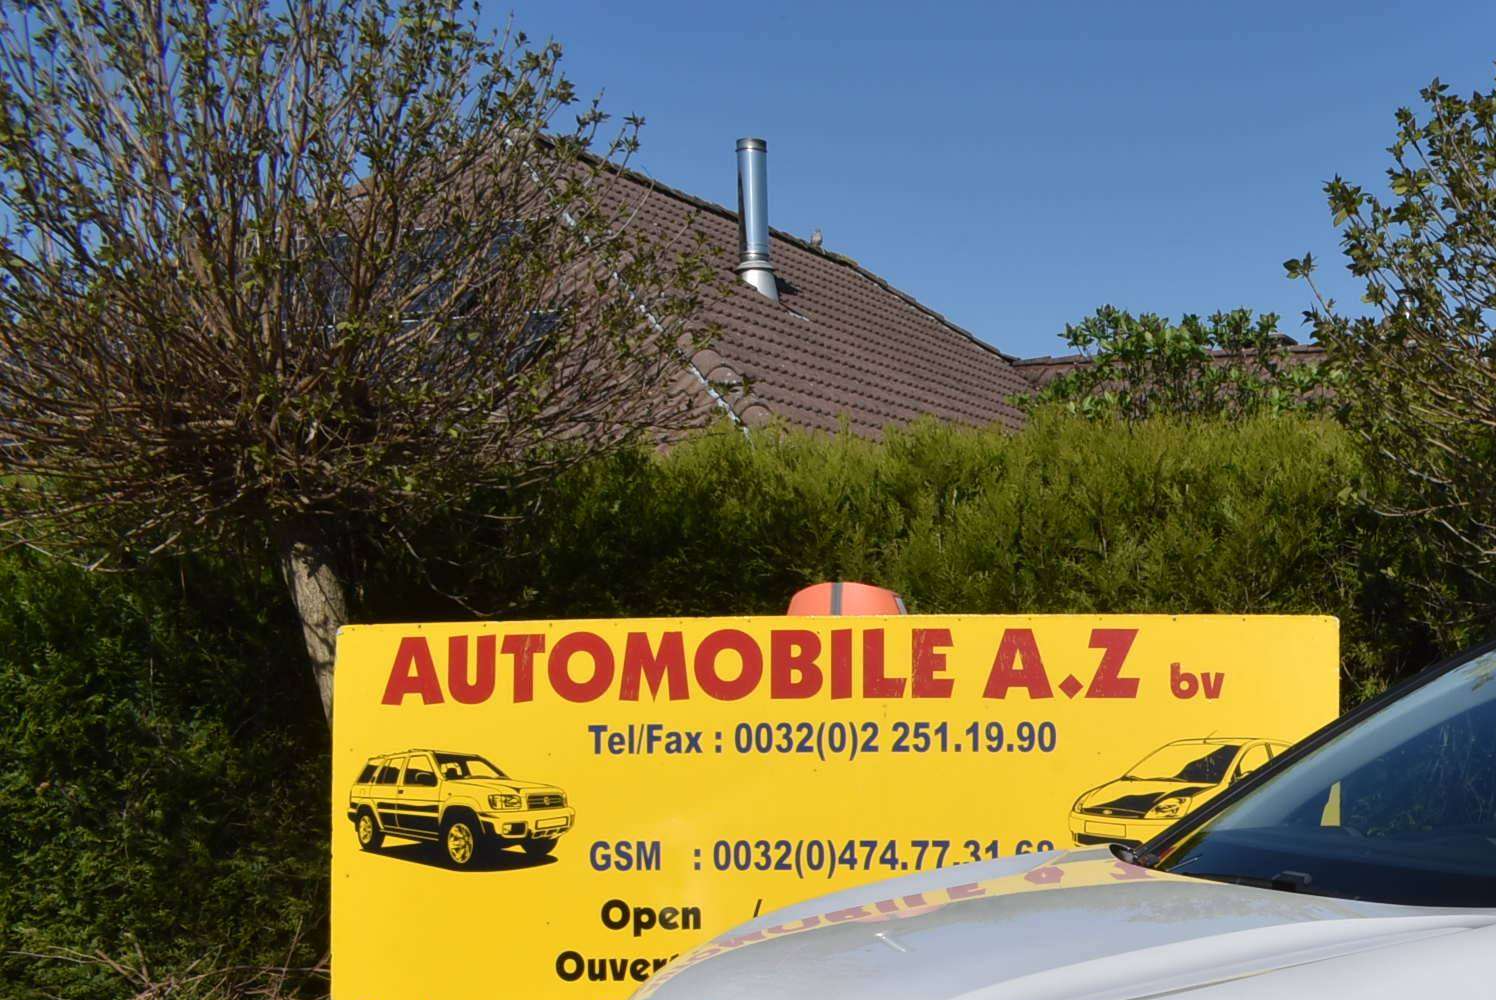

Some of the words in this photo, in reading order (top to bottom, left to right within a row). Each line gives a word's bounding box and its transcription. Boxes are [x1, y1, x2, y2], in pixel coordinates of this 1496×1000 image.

[381, 628, 955, 706] AUTOMOBILE
[982, 628, 1140, 700] A.Z
[1170, 662, 1225, 700] bv
[588, 724, 703, 755] Tel/Fax
[734, 721, 879, 762] 0032(0)2
[891, 721, 1057, 753] 251.19.90
[589, 840, 661, 872] GSM
[713, 839, 1054, 879] 0032(0)474.7731
[600, 898, 701, 938] Open
[555, 950, 679, 983] Ouver
